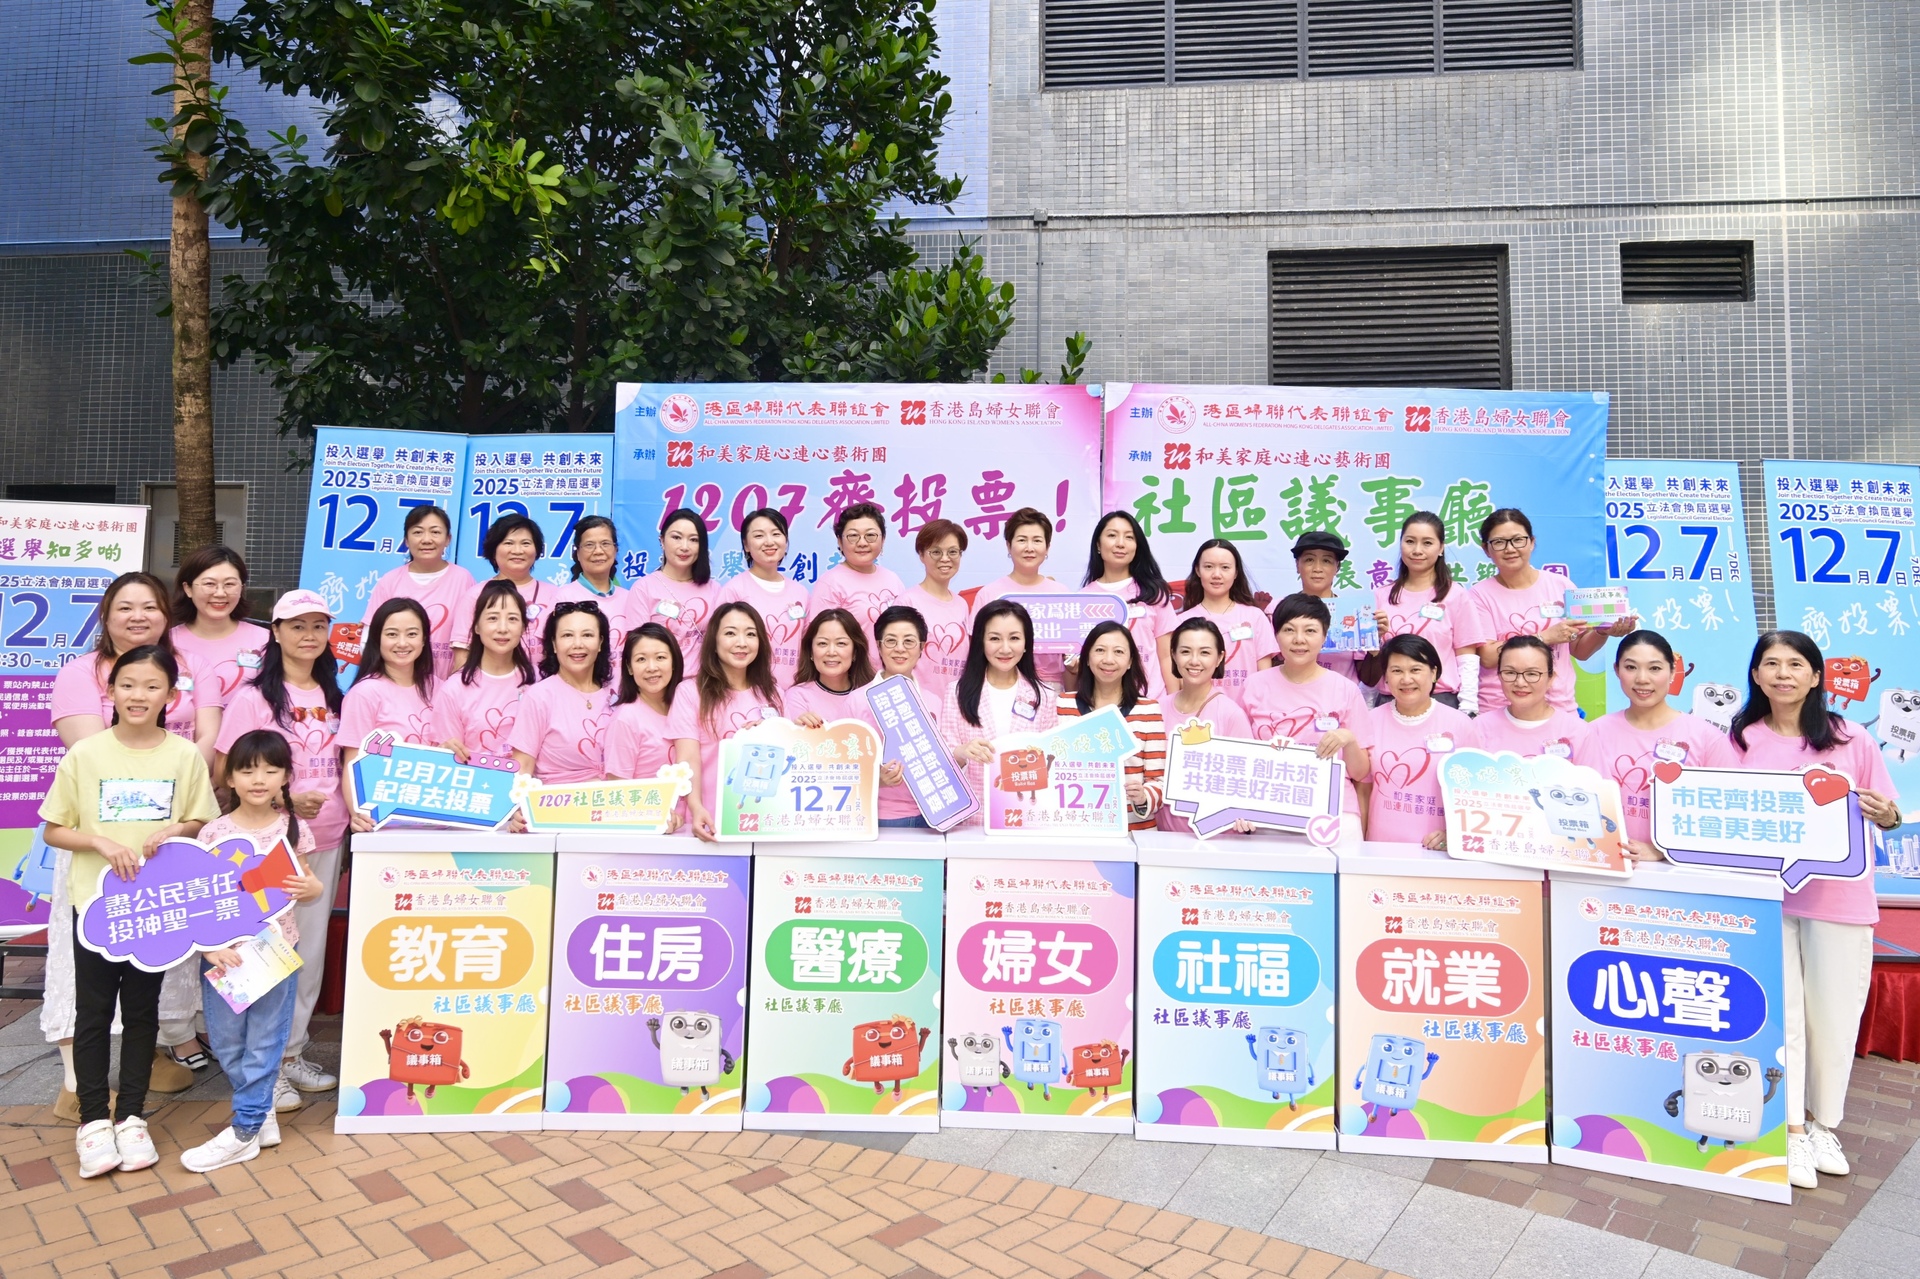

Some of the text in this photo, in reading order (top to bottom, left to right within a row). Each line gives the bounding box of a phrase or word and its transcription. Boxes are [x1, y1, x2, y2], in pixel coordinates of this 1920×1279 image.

[634, 406, 656, 417] 主辦
[704, 401, 890, 417] 港區婦聯代表聯誼會
[929, 400, 1062, 419] 香港島婦女聯會
[1130, 407, 1153, 419] 主辦
[1203, 404, 1394, 423] 港區婦聯代表聯誼會
[1435, 407, 1570, 428] 香港島婦女聯會
[326, 445, 456, 465] 投入選舉 共創未來
[475, 452, 602, 467] 投入選舉 共創未來
[633, 448, 656, 460] 承辦
[697, 445, 887, 464] 和美家庭心連心藝術團
[1128, 450, 1152, 462] 承辦
[1195, 448, 1391, 469] 和美家庭心連心藝術團
[322, 470, 453, 489] 2025 立法會換屆選舉
[473, 478, 601, 495] 2025 立法會換屆選舉
[1666, 478, 1729, 492] 共創未來
[1777, 477, 1911, 496] 投入選舉 共創未來
[1646, 502, 1732, 514] 立法會換屆選舉
[1779, 503, 1913, 522] 2025 立法會換屆選舉
[1780, 527, 1907, 586] 12月7日
[1729, 561, 1740, 581] DEC
[1833, 677, 1860, 690] 投票箱
[1891, 725, 1917, 741] 投票箱
[382, 757, 476, 790] 12月7日
[1055, 772, 1078, 781] 2025
[1182, 751, 1319, 785] 齊投票 創未來
[791, 776, 817, 784] 2025
[1182, 771, 1315, 808] 共建美好家園
[372, 779, 495, 816] 記得去投票
[539, 789, 662, 809] 1207社區議事廳
[791, 786, 852, 812] 12月7日
[1055, 783, 1111, 810] 12月7日
[1455, 798, 1483, 809] 2025
[1672, 786, 1806, 815] 市民齊投票
[763, 813, 867, 827] 香港島婦女聯會
[1025, 810, 1118, 824] 香港島婦女聯會
[1454, 809, 1525, 840] 12月7日
[1558, 818, 1590, 830] 投票箱
[1672, 813, 1807, 844] 社會更美好
[1489, 838, 1610, 864] 香港島婦女聯會
[404, 868, 530, 881] 港區婦聯代表聯誼會
[606, 869, 728, 883] 港區婦聯代表聯誼會
[803, 873, 922, 887] 港區婦聯代表聯誼會
[993, 878, 1113, 891] 港區婦聯代表聯誼會
[1189, 884, 1313, 899] 港區婦聯代表聯誼會
[105, 870, 238, 919] 盡公民責任
[415, 893, 507, 907] 香港島婦女聯會
[617, 893, 706, 907] 香港島婦女聯會
[814, 897, 902, 911] 香港島婦女聯會
[1392, 892, 1520, 908] 港區婦聯代表聯誼會
[1004, 902, 1092, 916] 香港島婦女聯會
[1201, 909, 1292, 923] 香港島婦女聯會
[1608, 903, 1756, 928] 港區婦聯代表聯誼會
[108, 896, 241, 945] 投神聖一票
[1405, 917, 1498, 933] 香港島婦女聯會
[1622, 928, 1729, 953] 香港島婦女聯會
[388, 924, 508, 983] 教育
[589, 923, 704, 983] 住房
[790, 927, 903, 985] 醫療
[981, 929, 1093, 987] 婦女
[1176, 939, 1291, 998] 社福
[1381, 946, 1502, 1009] 就業
[433, 993, 537, 1015] 社區議事廳
[564, 993, 664, 1015] 社區議事廳
[764, 998, 844, 1014] 社區議事廳
[1593, 961, 1731, 1033] 心聲
[989, 998, 1087, 1018] 社區議事廳
[1153, 1008, 1253, 1030] 社區議事廳
[1423, 1020, 1527, 1044] 社區議事廳
[1571, 1030, 1680, 1062] 社區議事廳
[406, 1053, 443, 1067] 議事箱
[869, 1053, 904, 1067] 議事箱
